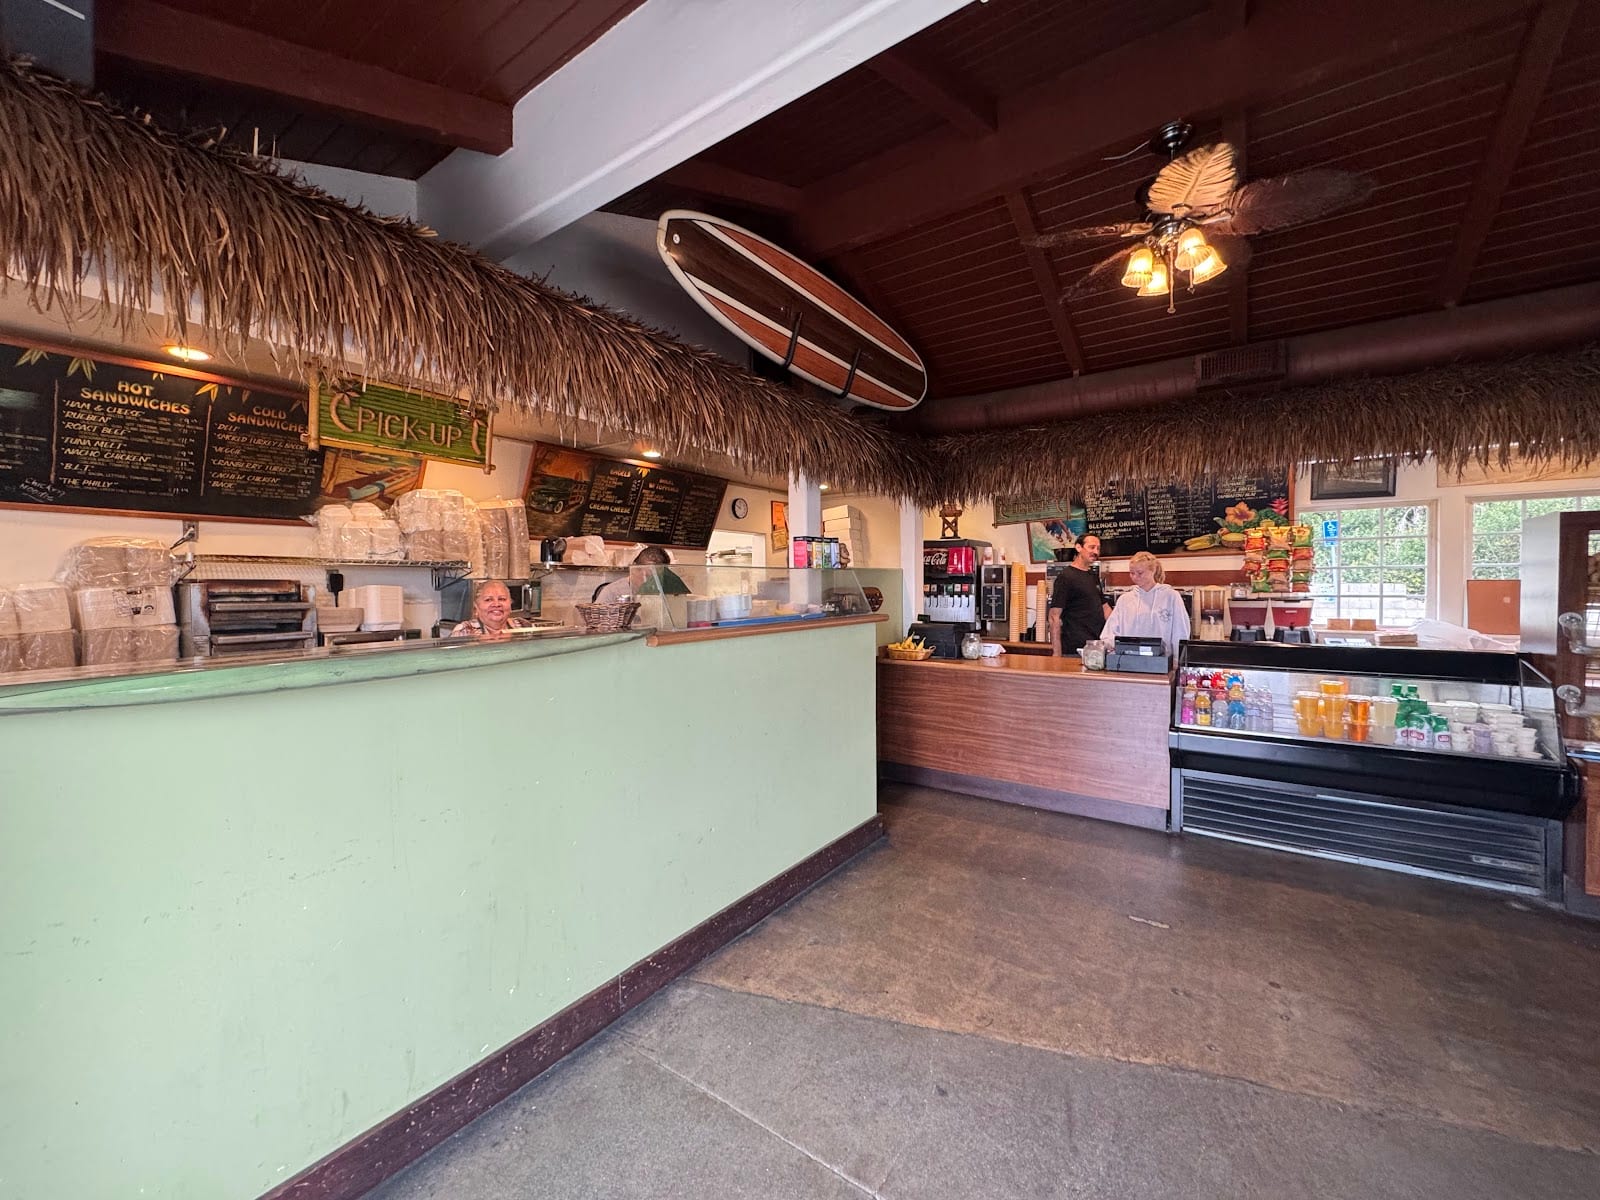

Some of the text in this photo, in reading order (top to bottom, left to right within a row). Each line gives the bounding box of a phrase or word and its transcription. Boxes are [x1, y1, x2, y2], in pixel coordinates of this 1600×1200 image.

[118, 381, 154, 396] HOT
[80, 387, 191, 415] SANDWICHES
[253, 406, 287, 419] COLD
[357, 406, 462, 448] PICK-UP
[1088, 520, 1145, 530] BLENDED DRINKS
